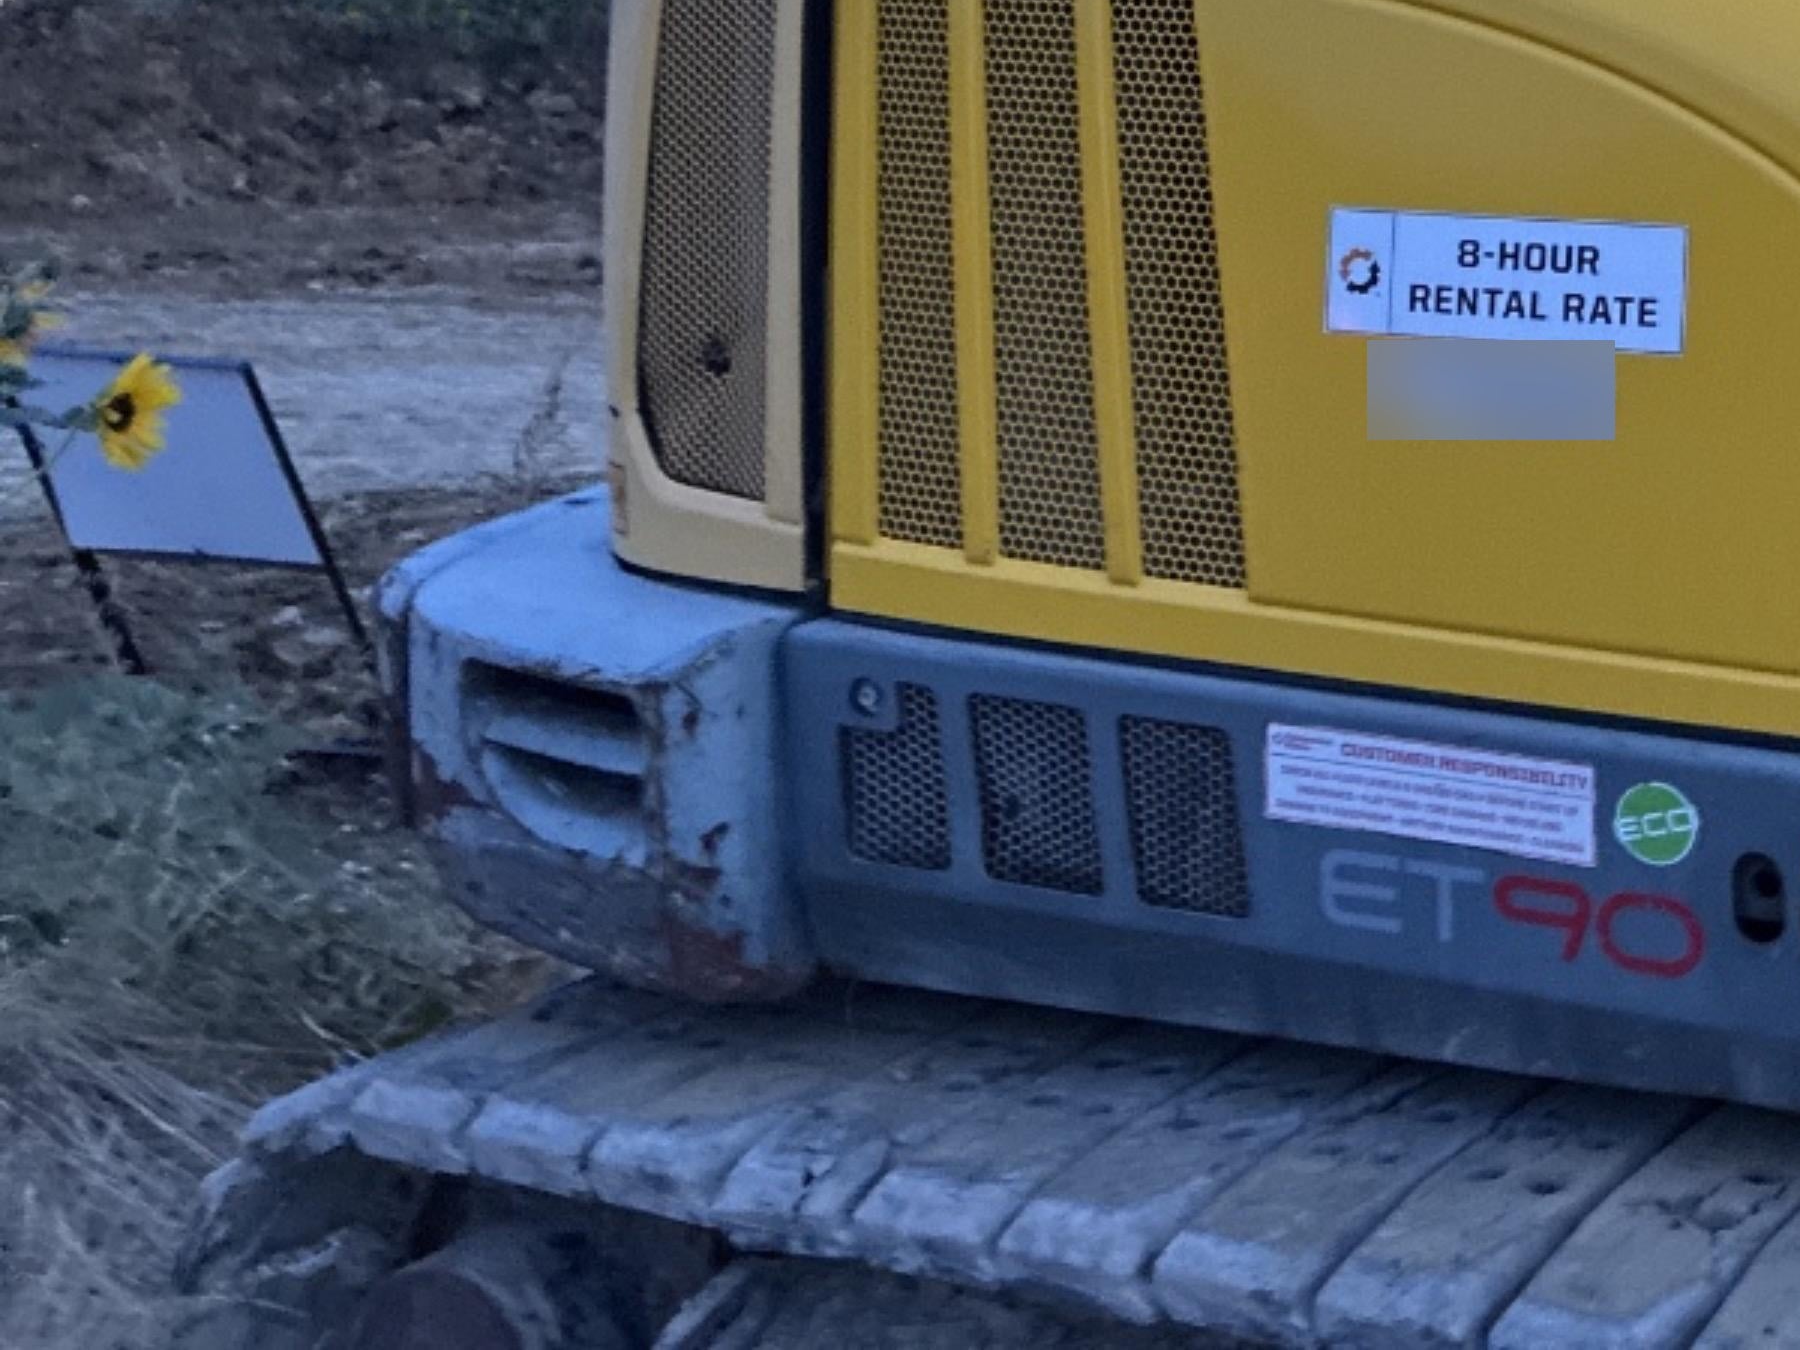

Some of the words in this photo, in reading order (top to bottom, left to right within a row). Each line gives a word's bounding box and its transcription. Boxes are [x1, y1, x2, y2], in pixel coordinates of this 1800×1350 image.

[1456, 238, 1601, 276] 8-HOUR
[1408, 283, 1547, 322] RENTAL
[1562, 292, 1659, 328] RATE
[1340, 742, 1436, 770] CUSTOMER
[1613, 807, 1699, 843] ECO
